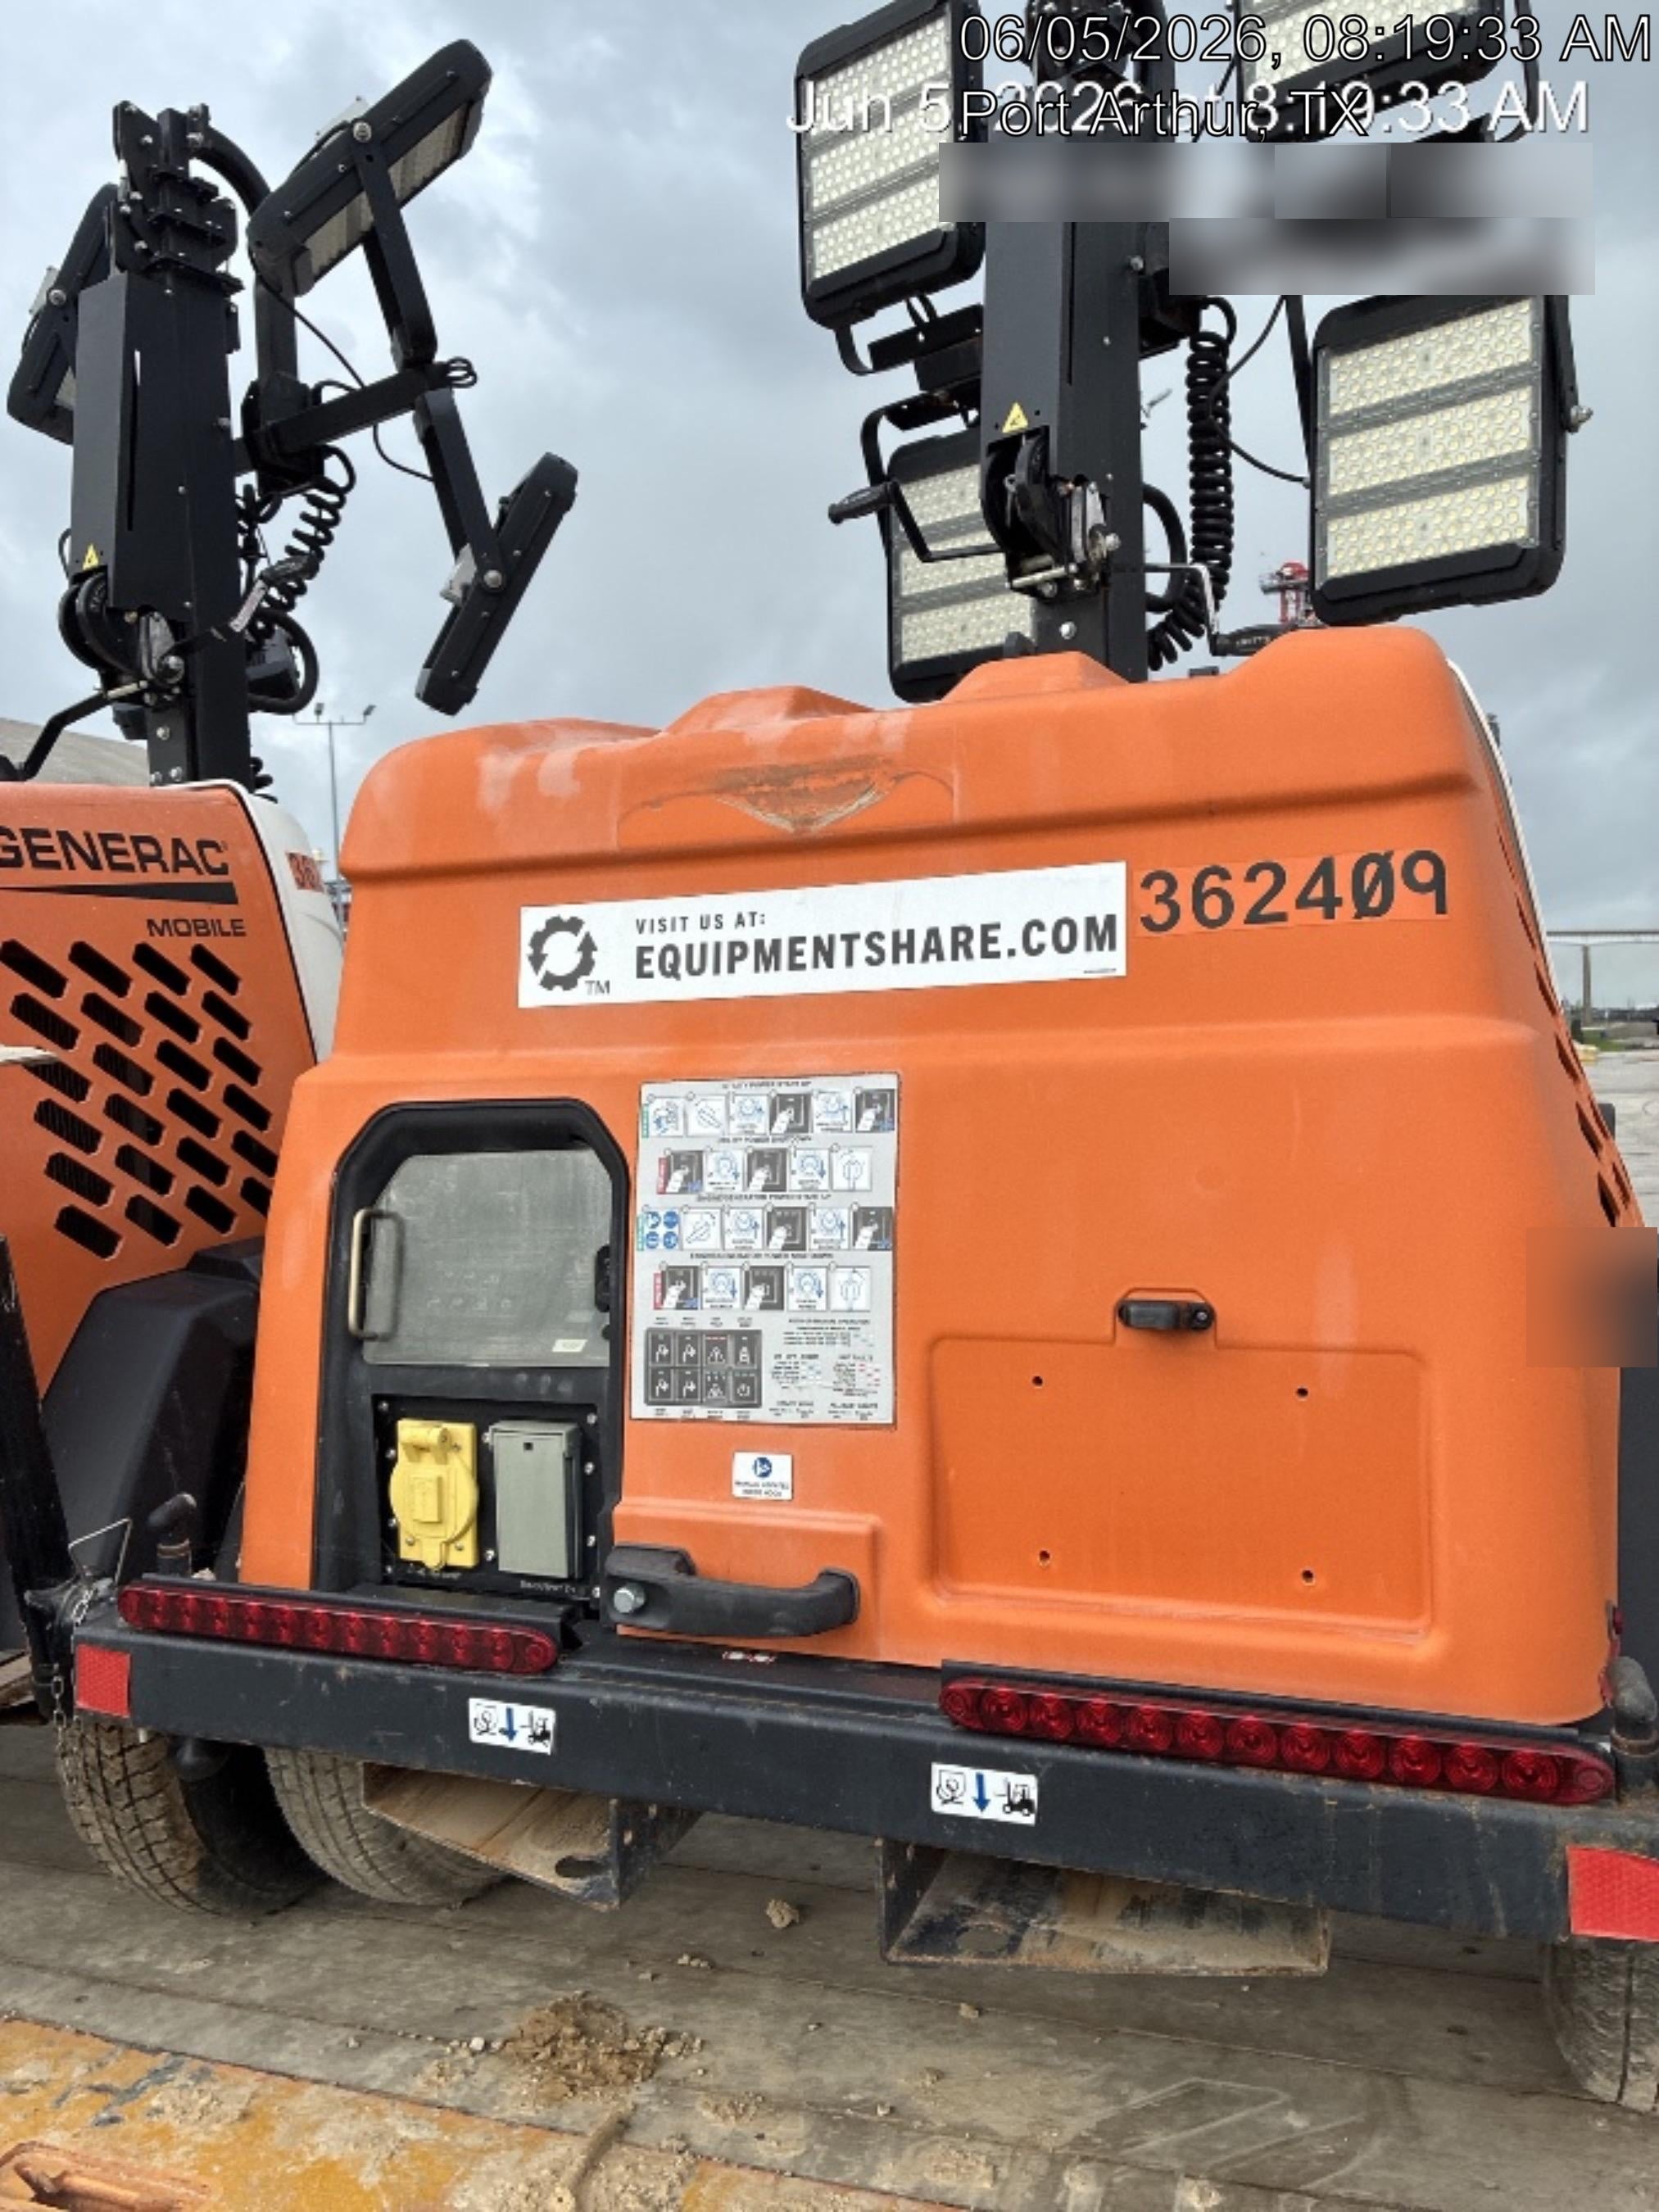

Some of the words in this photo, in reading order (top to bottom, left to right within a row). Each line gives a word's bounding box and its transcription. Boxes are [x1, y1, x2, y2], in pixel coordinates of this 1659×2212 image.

[1140, 850, 1448, 933] 362409
[146, 918, 246, 937] MOBILE
[636, 916, 689, 935] VISIT
[700, 913, 723, 931] US
[734, 911, 766, 930] AT:
[636, 913, 1117, 981] EQUIPMENTSHARE.COM
[584, 980, 611, 995] TM
